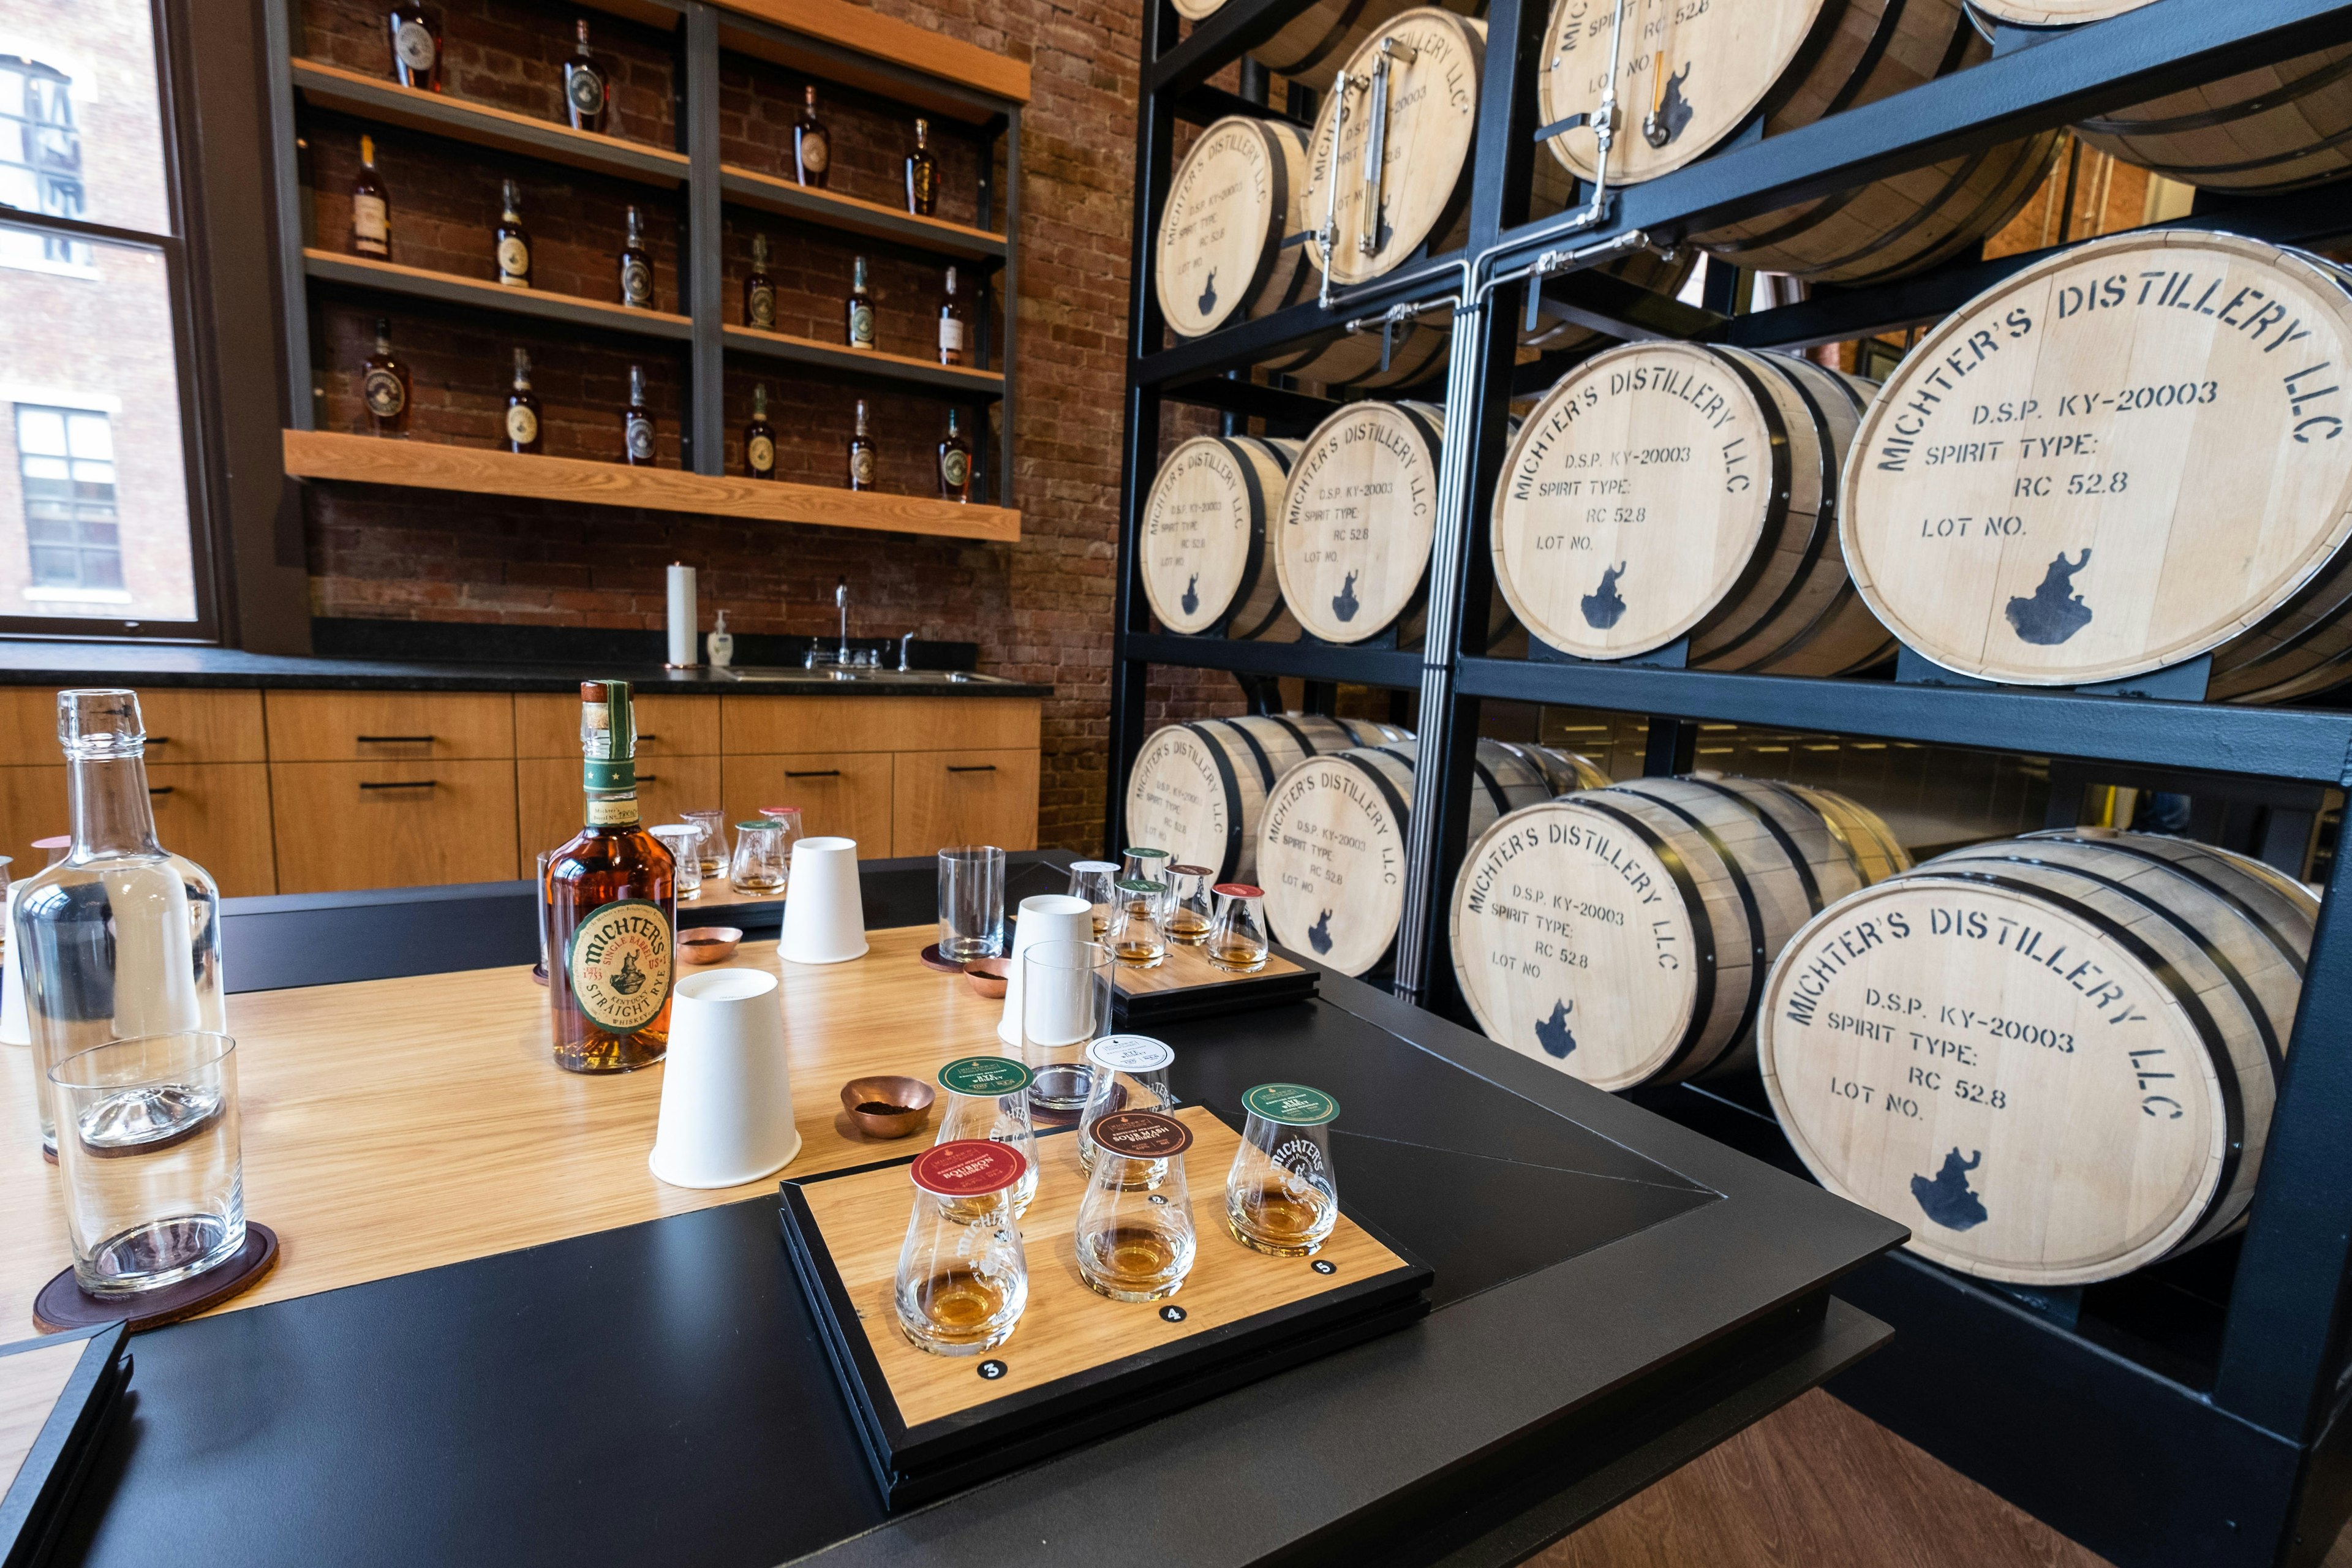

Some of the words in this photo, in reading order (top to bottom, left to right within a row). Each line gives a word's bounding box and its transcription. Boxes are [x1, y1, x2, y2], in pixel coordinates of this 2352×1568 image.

[1446, 62, 1466, 106] LLC
[1167, 159, 1204, 246] MICHTER'S
[1208, 134, 1259, 167] DISTILLERY
[1254, 168, 1267, 203] LLC
[1877, 307, 2032, 472] MICHTER'S
[2058, 271, 2311, 353] DISTILLERY
[2283, 361, 2342, 443] LLC
[1972, 402, 2043, 426] D.S.P.
[2058, 380, 2218, 418] KY-20003
[1513, 386, 1597, 500] MICHTER'S
[1611, 368, 1736, 429] DISTILLERY
[1722, 437, 1750, 493] LLC
[1565, 454, 1602, 469] D.S.P.
[1611, 447, 1691, 467] KY-20003
[1924, 441, 2003, 466] SPIRIT
[2019, 433, 2100, 460] TYPE:
[1289, 436, 1339, 525] MICHTER'S
[1345, 423, 1417, 469] DISTILLERY
[1410, 475, 1427, 517] LLC
[2014, 477, 2051, 498] RC
[2067, 472, 2128, 496] 52.8
[1150, 463, 1185, 535] MICHTER'S
[1188, 452, 1237, 491] DISTILLERY
[1232, 497, 1243, 529] LLC
[1346, 483, 1393, 497] KY-20003
[1539, 481, 1581, 497] SPIRIT
[1591, 479, 1631, 495] TYPE:
[1305, 510, 1330, 521] SPIRIT
[1586, 509, 1606, 523] RC
[1613, 508, 1646, 522] 52.8
[1333, 530, 1346, 541] RC
[1921, 516, 1972, 538] LOT
[1984, 516, 2027, 537] NO.
[1536, 537, 1564, 550] LOT
[1304, 552, 1321, 562] LOT
[1136, 744, 1169, 799] MICHTER'S
[1174, 741, 1218, 793] DISTILLERY
[1213, 802, 1223, 834] LLC
[1268, 775, 1314, 843] MICHTER'S
[1321, 772, 1388, 835] DISTILLERY
[1382, 847, 1396, 885] LLC
[1322, 830, 1366, 852] KY-20003
[1283, 872, 1298, 887] LOT
[1310, 864, 1321, 876] RC
[1468, 827, 1539, 913] MICHTER'S
[1549, 824, 1662, 905] DISTILLERY
[1652, 920, 1679, 971] LLC
[1513, 884, 1546, 906] D.S.P.
[1553, 895, 1624, 926] KY-20003
[1491, 903, 1529, 924] SPIRIT
[585, 916, 665, 965] MICHTER'S
[603, 937, 627, 965] SINGLE
[630, 936, 652, 960] BARREL
[1535, 941, 1553, 957] RC
[1492, 951, 1517, 970] LOT
[587, 984, 650, 1017] STRAIGHT
[650, 970, 665, 996] RYE
[611, 990, 648, 1005] KENTUCKY
[612, 1012, 648, 1025] WHISKEY
[1786, 911, 1910, 1027] MICHTER'S
[1931, 908, 2147, 1025] DISTILLERY
[2128, 1047, 2184, 1120] LLC
[1865, 987, 1927, 1019] D.S.P.
[1940, 1006, 2075, 1054] KY-20003
[1827, 1011, 1895, 1044] SPIRIT
[1909, 1033, 1978, 1066] TYPE:
[1830, 1077, 1874, 1103] LOT
[1886, 1093, 1924, 1121] NO.
[1909, 1066, 1941, 1092] RC
[1954, 1080, 2007, 1110] 52.8
[1112, 1131, 1140, 1142] SOUR
[1141, 1126, 1169, 1136] MASH
[1129, 1133, 1160, 1142] WHISKEY
[1270, 1139, 1324, 1171] MICHTER'S
[943, 1156, 994, 1179] BOURBON
[955, 1163, 990, 1178] WHISKEY
[1315, 1261, 1331, 1273] 5
[1167, 1308, 1181, 1321] 4
[984, 1363, 1000, 1376] 3
